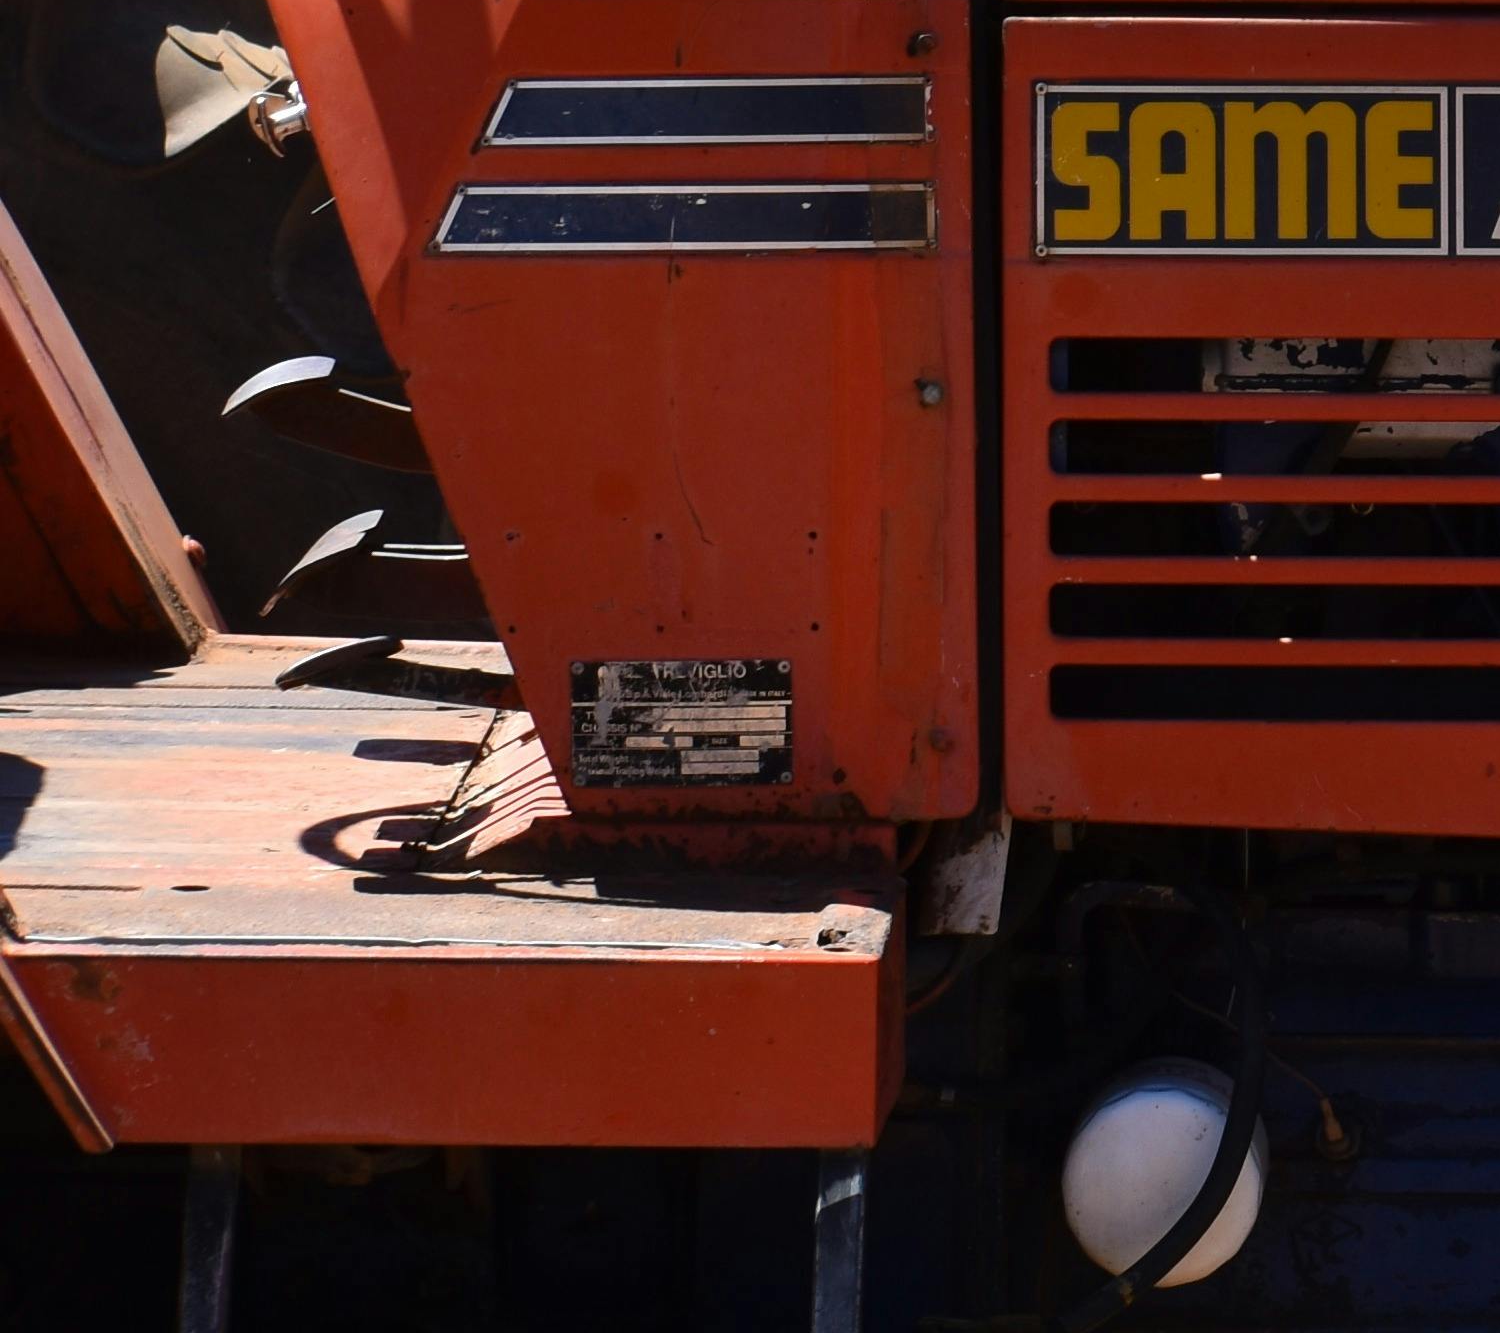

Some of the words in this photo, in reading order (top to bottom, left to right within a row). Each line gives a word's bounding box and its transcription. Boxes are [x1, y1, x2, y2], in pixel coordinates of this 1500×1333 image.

[1051, 100, 1434, 241] SAME
[652, 663, 747, 679] TRVIGLIO
[678, 689, 730, 700] Lombardi
